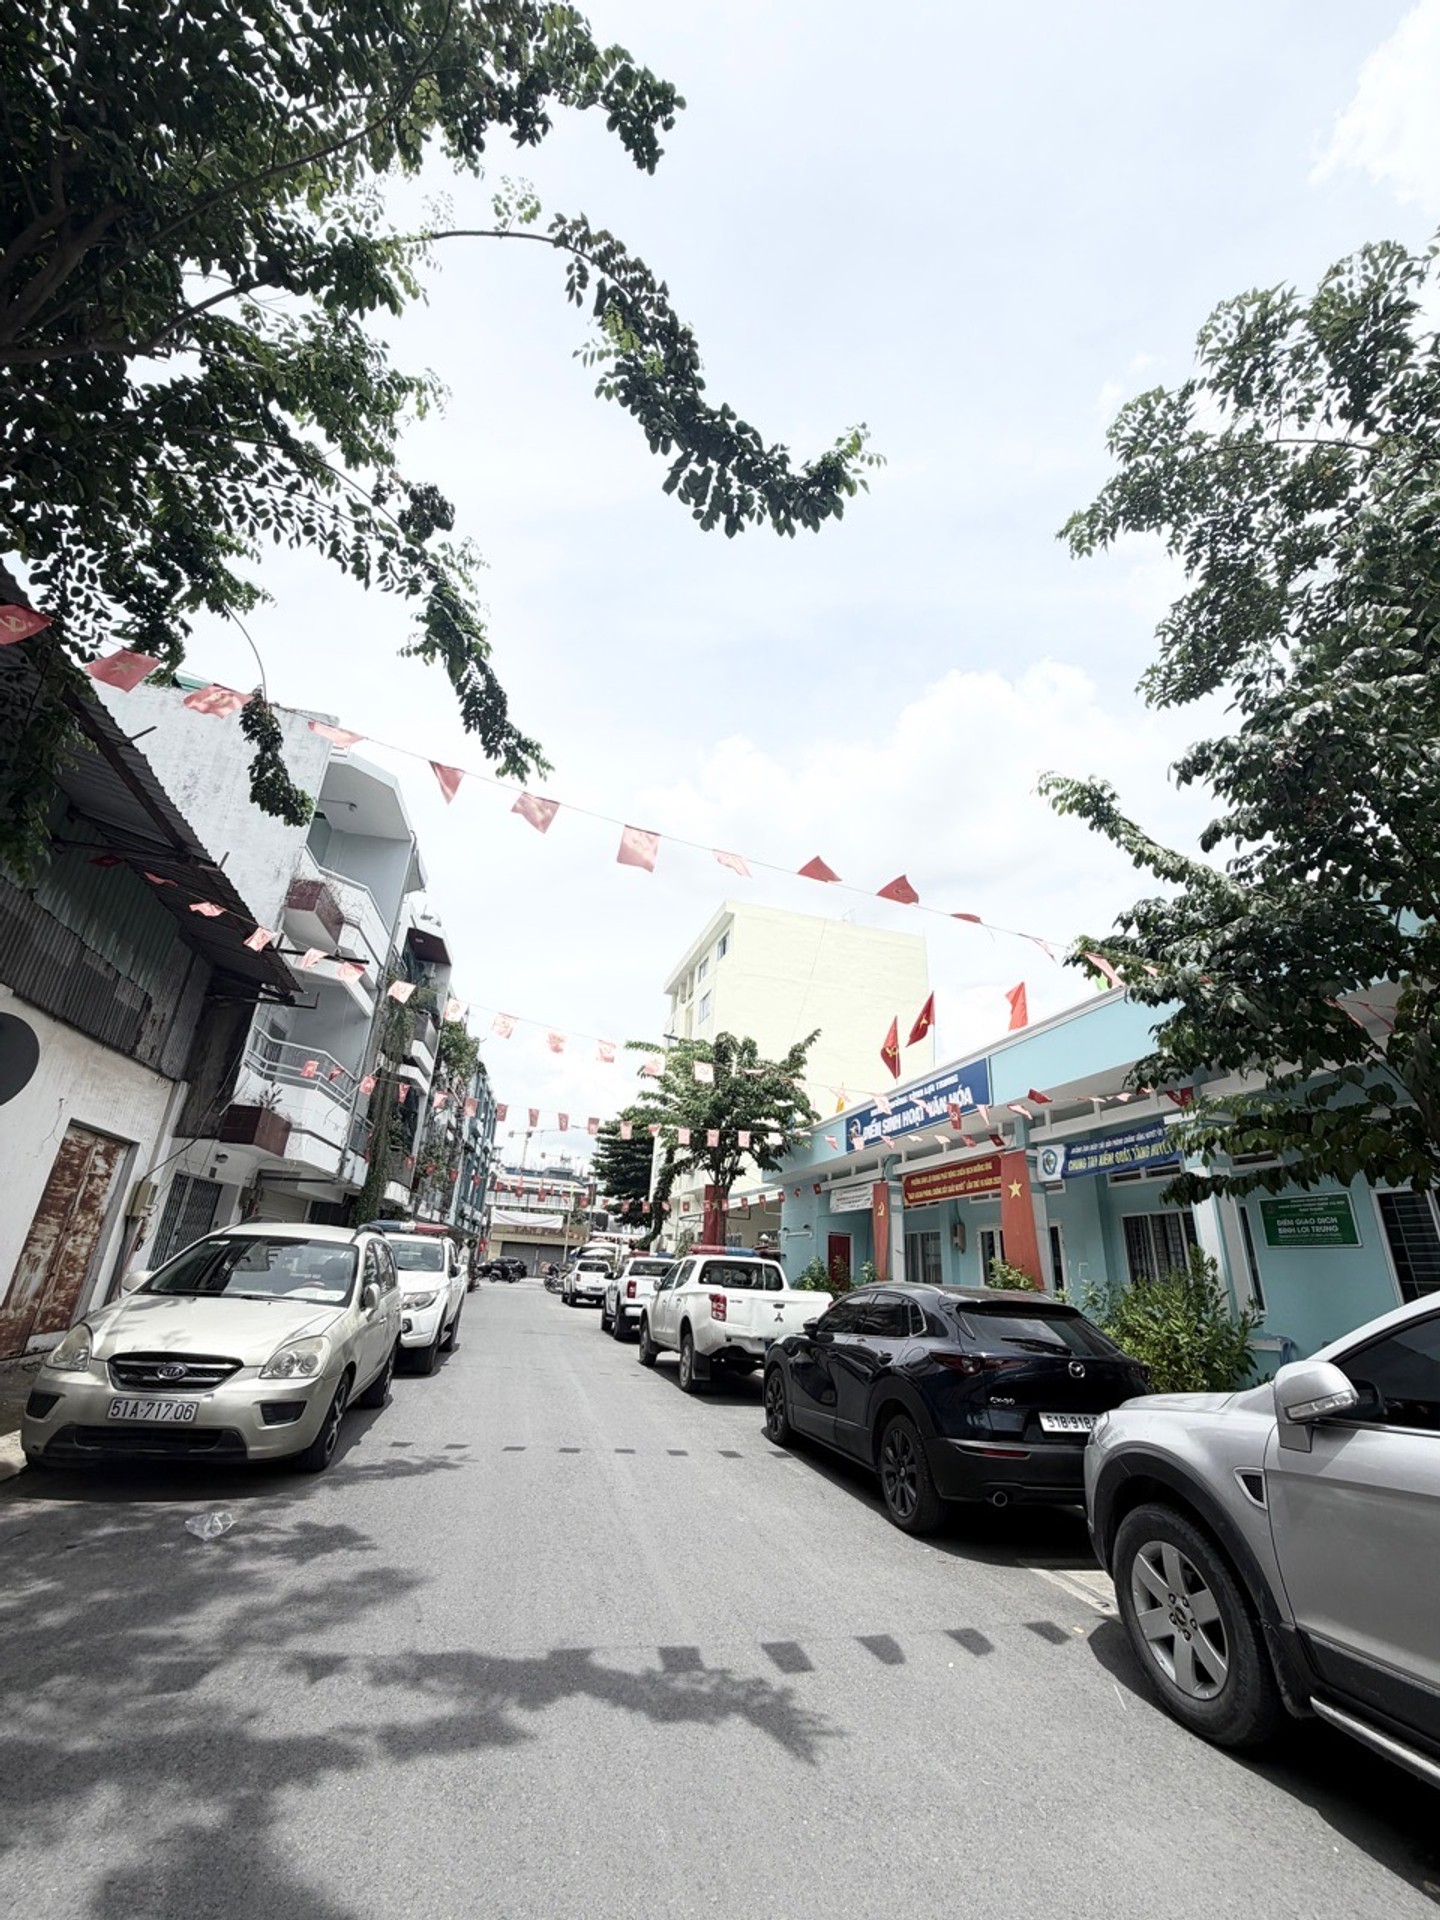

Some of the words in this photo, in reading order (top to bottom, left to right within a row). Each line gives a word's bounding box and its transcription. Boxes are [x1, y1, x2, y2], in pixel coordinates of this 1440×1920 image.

[882, 1112, 901, 1135] SINH
[902, 1105, 924, 1127] HOẠT
[926, 1094, 948, 1119] VĂN
[948, 1084, 973, 1108] HÓA
[1295, 1217, 1316, 1226] GIAO
[1311, 1224, 1340, 1233] TRUNG
[161, 1366, 180, 1377] KIA
